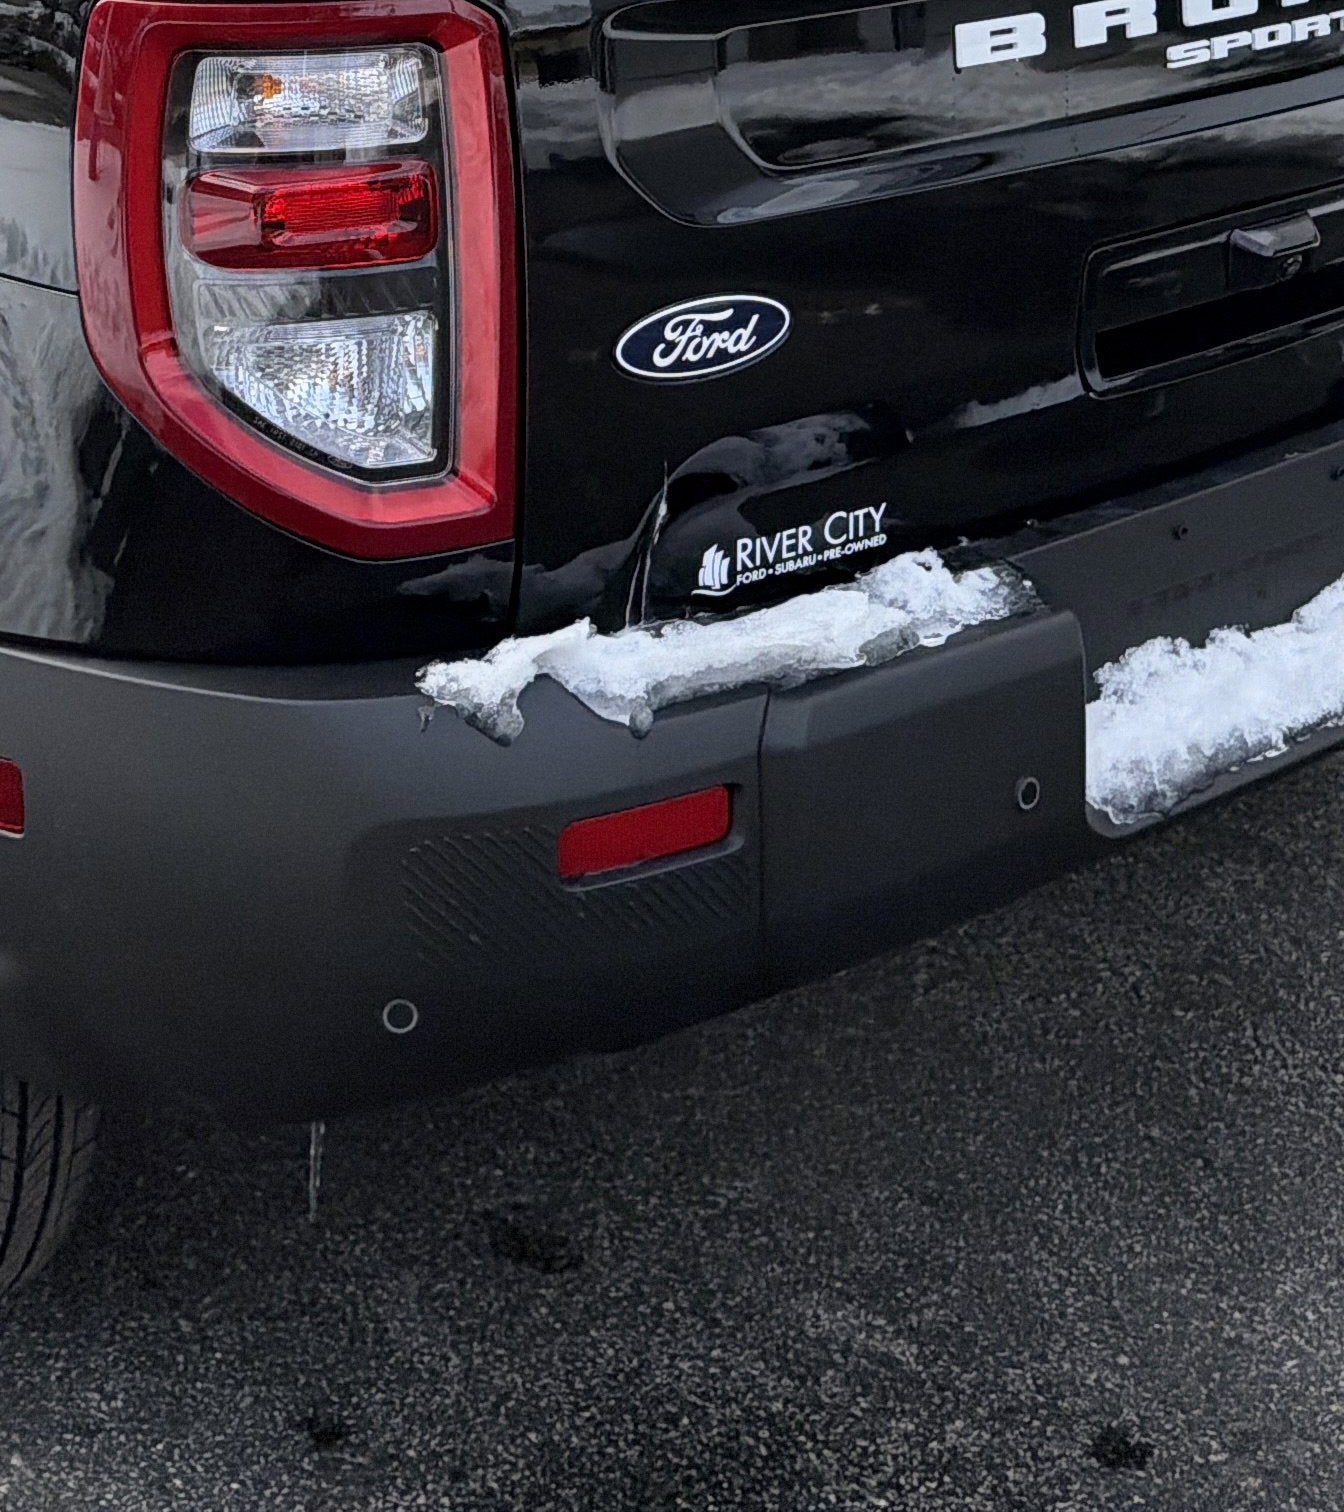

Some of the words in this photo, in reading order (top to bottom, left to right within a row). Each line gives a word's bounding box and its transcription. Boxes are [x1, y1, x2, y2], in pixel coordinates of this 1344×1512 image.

[652, 307, 760, 368] Ford
[735, 524, 814, 572] RIVER
[823, 501, 888, 545] CITY
[736, 567, 768, 587] FORD
[774, 553, 817, 576] SUBARU
[823, 533, 888, 562] PRE-OWNED
